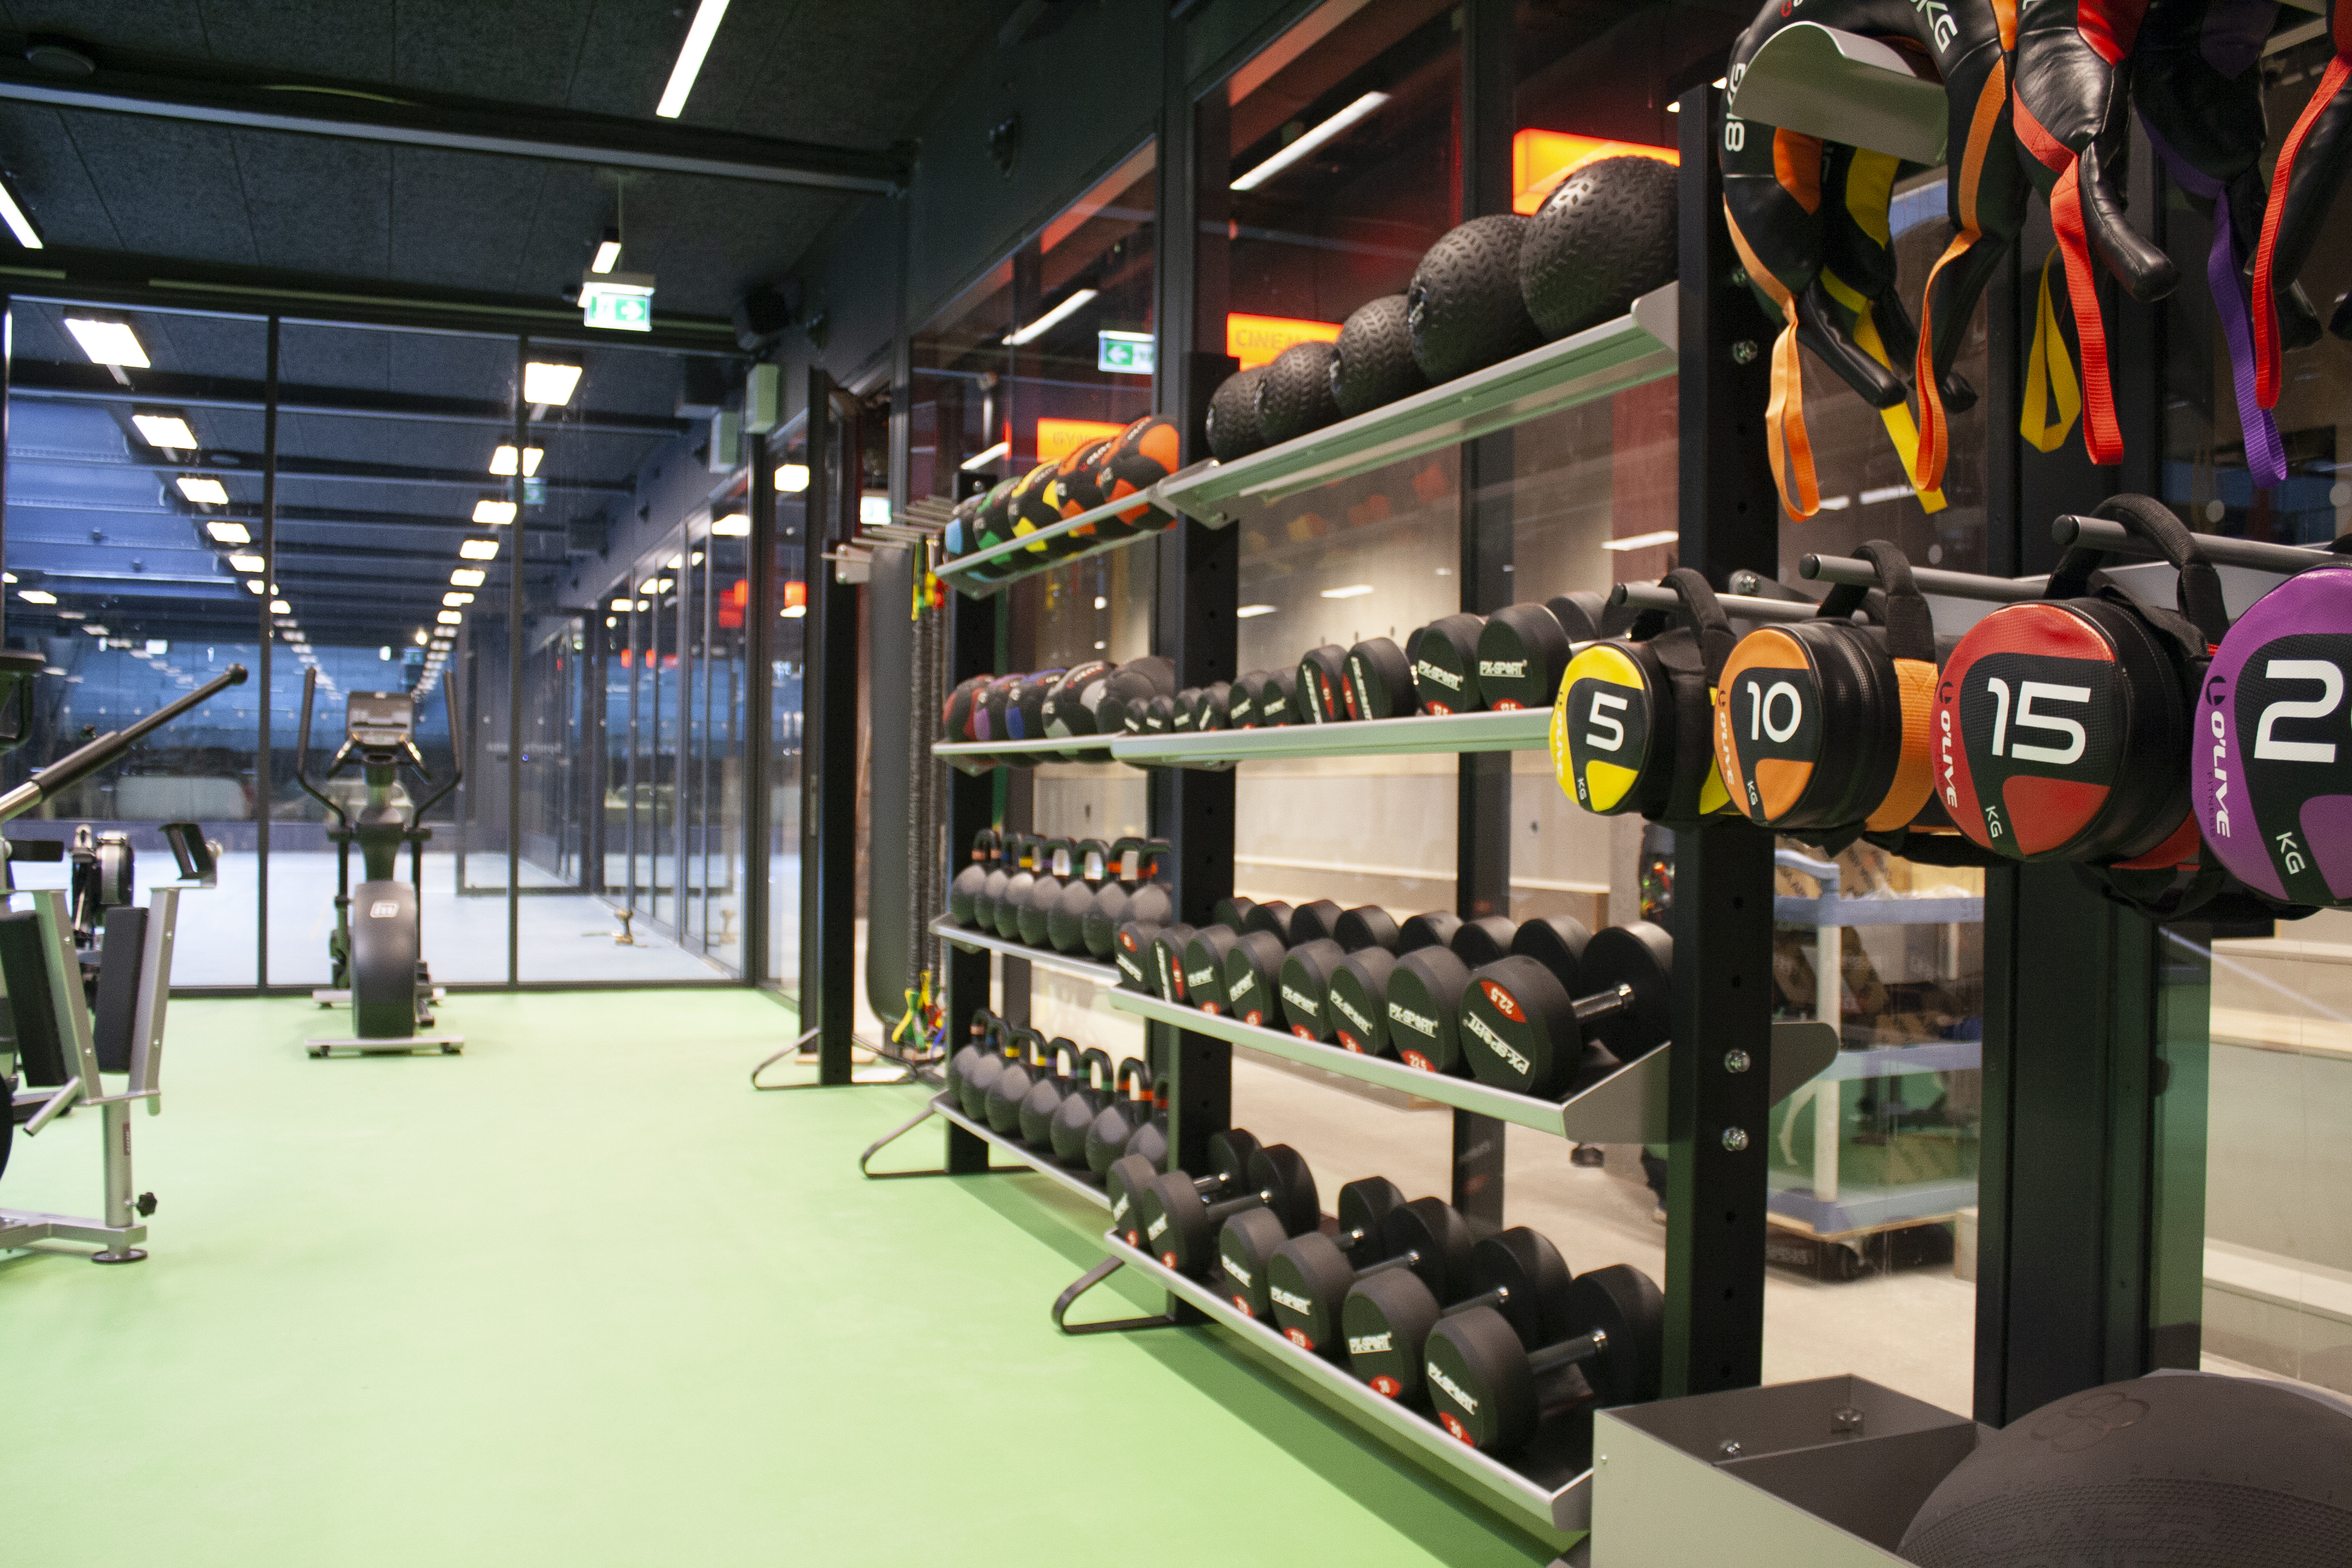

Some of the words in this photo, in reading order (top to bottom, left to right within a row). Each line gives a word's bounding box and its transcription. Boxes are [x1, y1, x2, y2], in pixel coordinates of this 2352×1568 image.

[1910, 0, 1958, 53] KG
[1725, 63, 1747, 151] 8G
[1586, 691, 1628, 752] 5
[1747, 681, 1802, 743] 10
[1987, 677, 2091, 765] 15
[2254, 659, 2352, 763] 2
[1577, 777, 1587, 800] KG
[1940, 710, 1958, 808] O'LIVE
[2211, 711, 2230, 838] O'LIVE
[1747, 780, 1759, 806] KG
[1985, 805, 2004, 838] KG
[2276, 831, 2305, 875] KG
[1489, 987, 1514, 1015] 22.5
